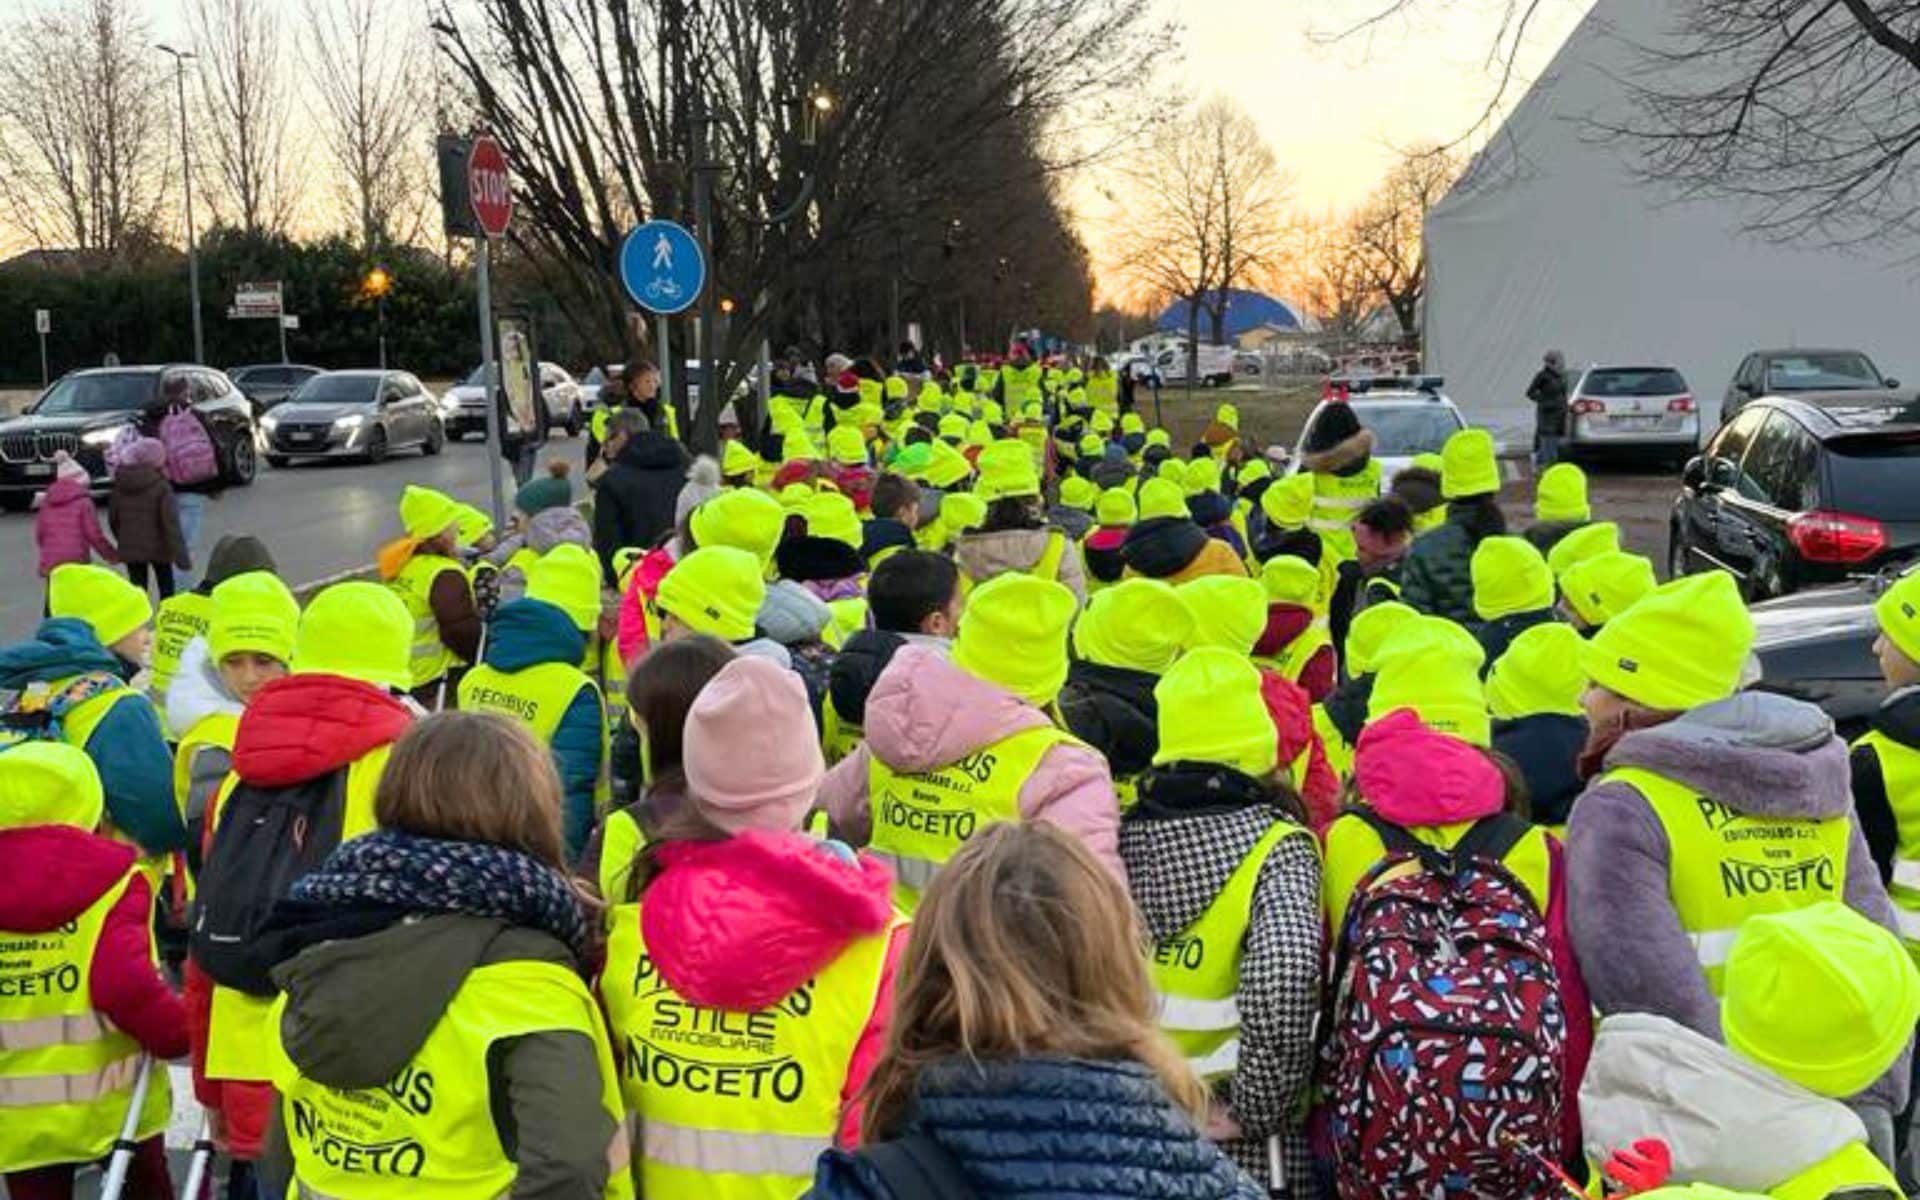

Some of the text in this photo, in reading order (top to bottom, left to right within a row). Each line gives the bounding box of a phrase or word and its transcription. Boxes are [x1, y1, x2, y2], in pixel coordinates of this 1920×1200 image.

[473, 169, 510, 206] STOP
[881, 795, 976, 841] NOCETO
[1156, 938, 1203, 970] ETO
[0, 965, 79, 995] CETO
[652, 999, 777, 1040] STILE
[626, 1035, 803, 1103] NOCETO
